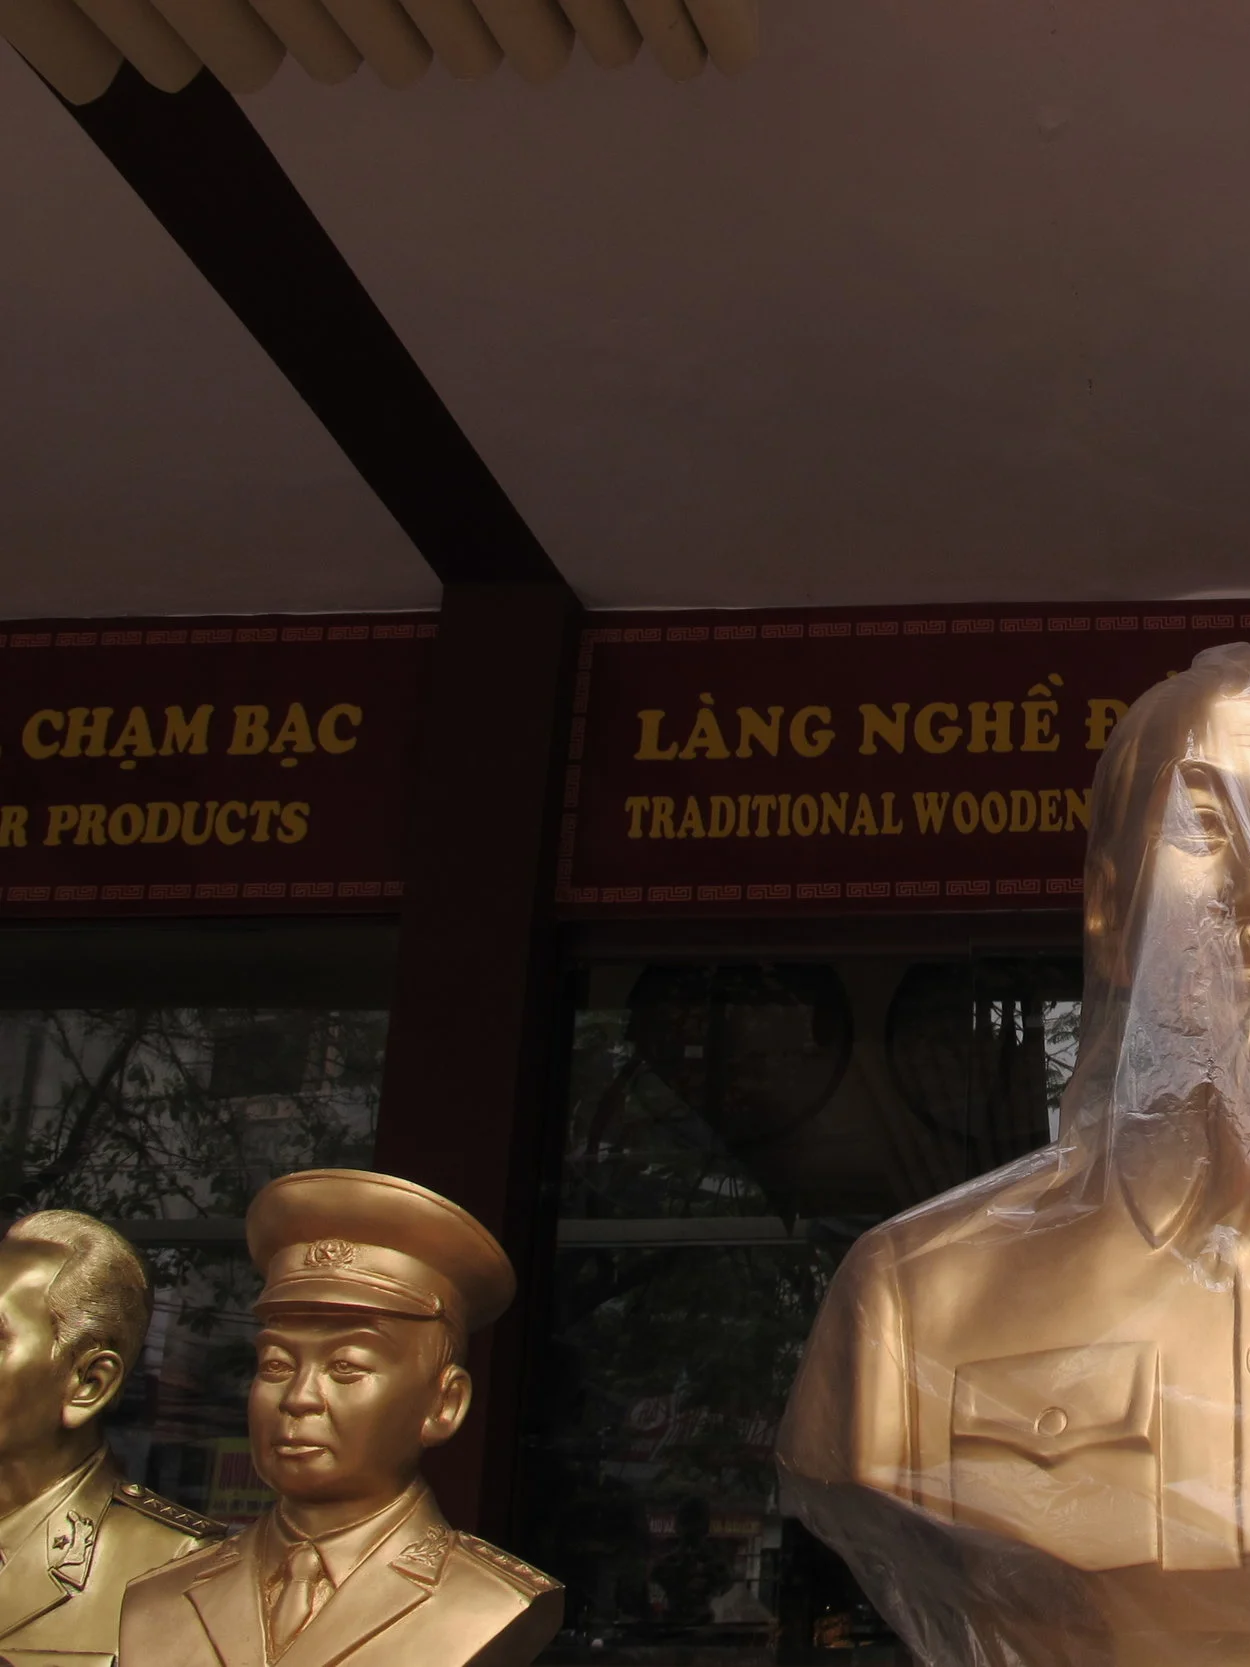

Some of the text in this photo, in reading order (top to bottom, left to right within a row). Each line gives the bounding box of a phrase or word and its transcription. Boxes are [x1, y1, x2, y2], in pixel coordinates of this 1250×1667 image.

[22, 702, 363, 771] CHẠM BẠC
[634, 692, 835, 761] LÀNG
[858, 673, 1064, 756] NGHỀ
[43, 800, 311, 847] PRODUCTS
[624, 788, 1094, 839] TRADITIONAL WOODEN
